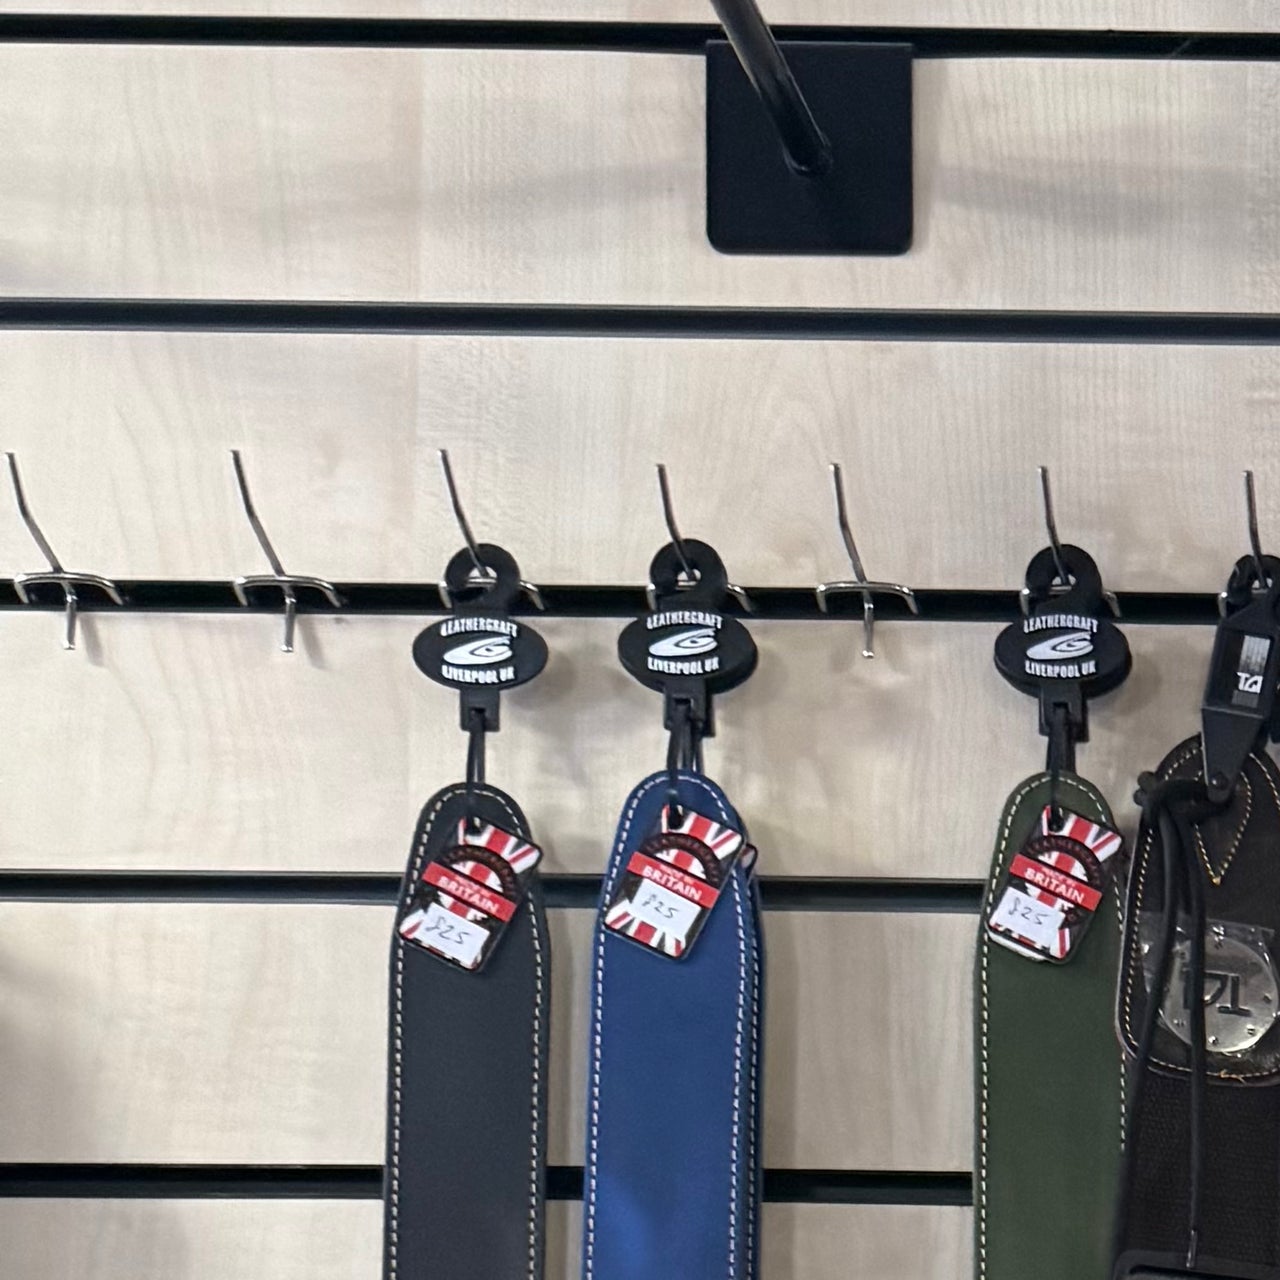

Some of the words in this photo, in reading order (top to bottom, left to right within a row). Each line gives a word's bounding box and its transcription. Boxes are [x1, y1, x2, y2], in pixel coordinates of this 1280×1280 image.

[441, 665, 499, 684] LIVERPOOL
[647, 656, 704, 675] LIVERPOOL
[704, 656, 719, 672] UK
[1025, 660, 1081, 678] LIVERPOOL
[1081, 660, 1096, 675] UK
[438, 875, 500, 913] BRITAIN
[642, 865, 703, 901] BRITAIN
[1024, 867, 1085, 904] BRITAIN
